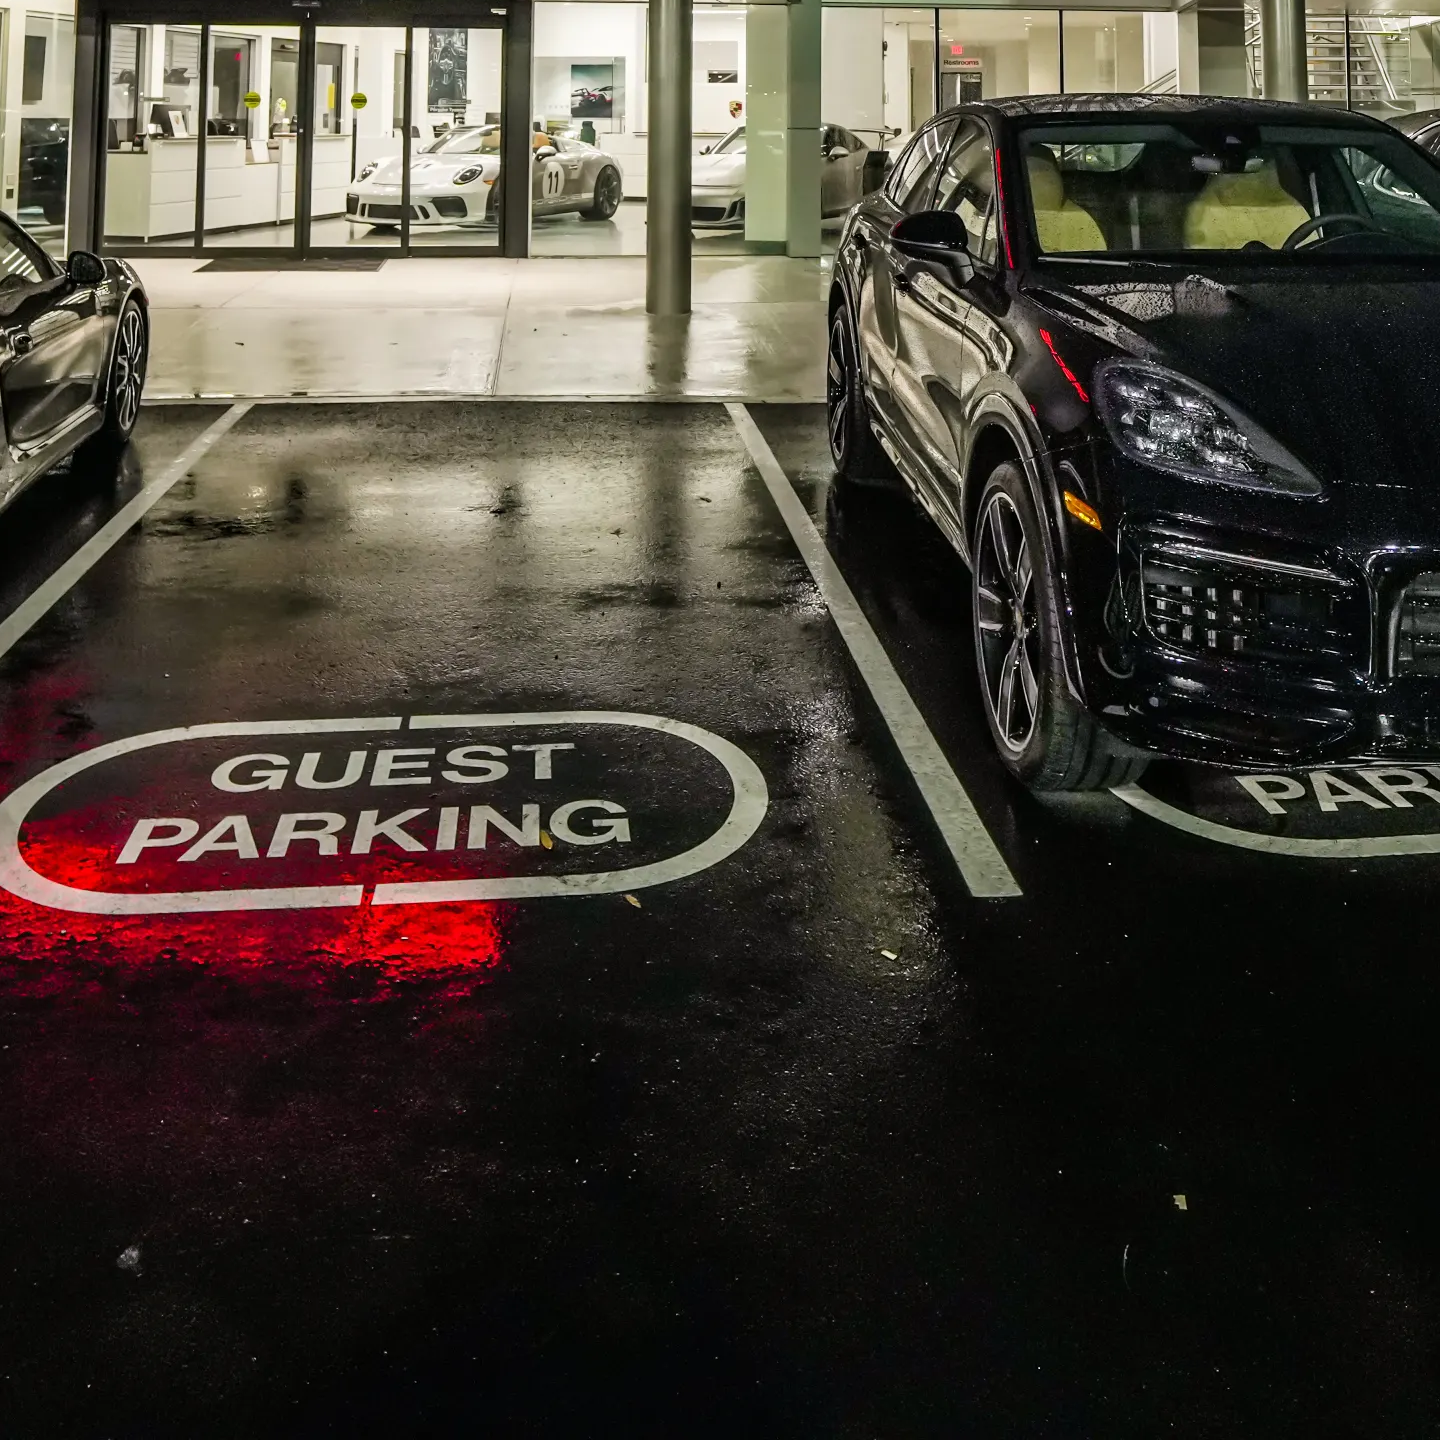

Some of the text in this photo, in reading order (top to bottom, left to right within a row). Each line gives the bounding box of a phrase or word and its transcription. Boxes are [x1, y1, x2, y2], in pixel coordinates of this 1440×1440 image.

[548, 171, 558, 193] 11
[210, 743, 575, 792] GUEST
[115, 799, 632, 864] PARKING
